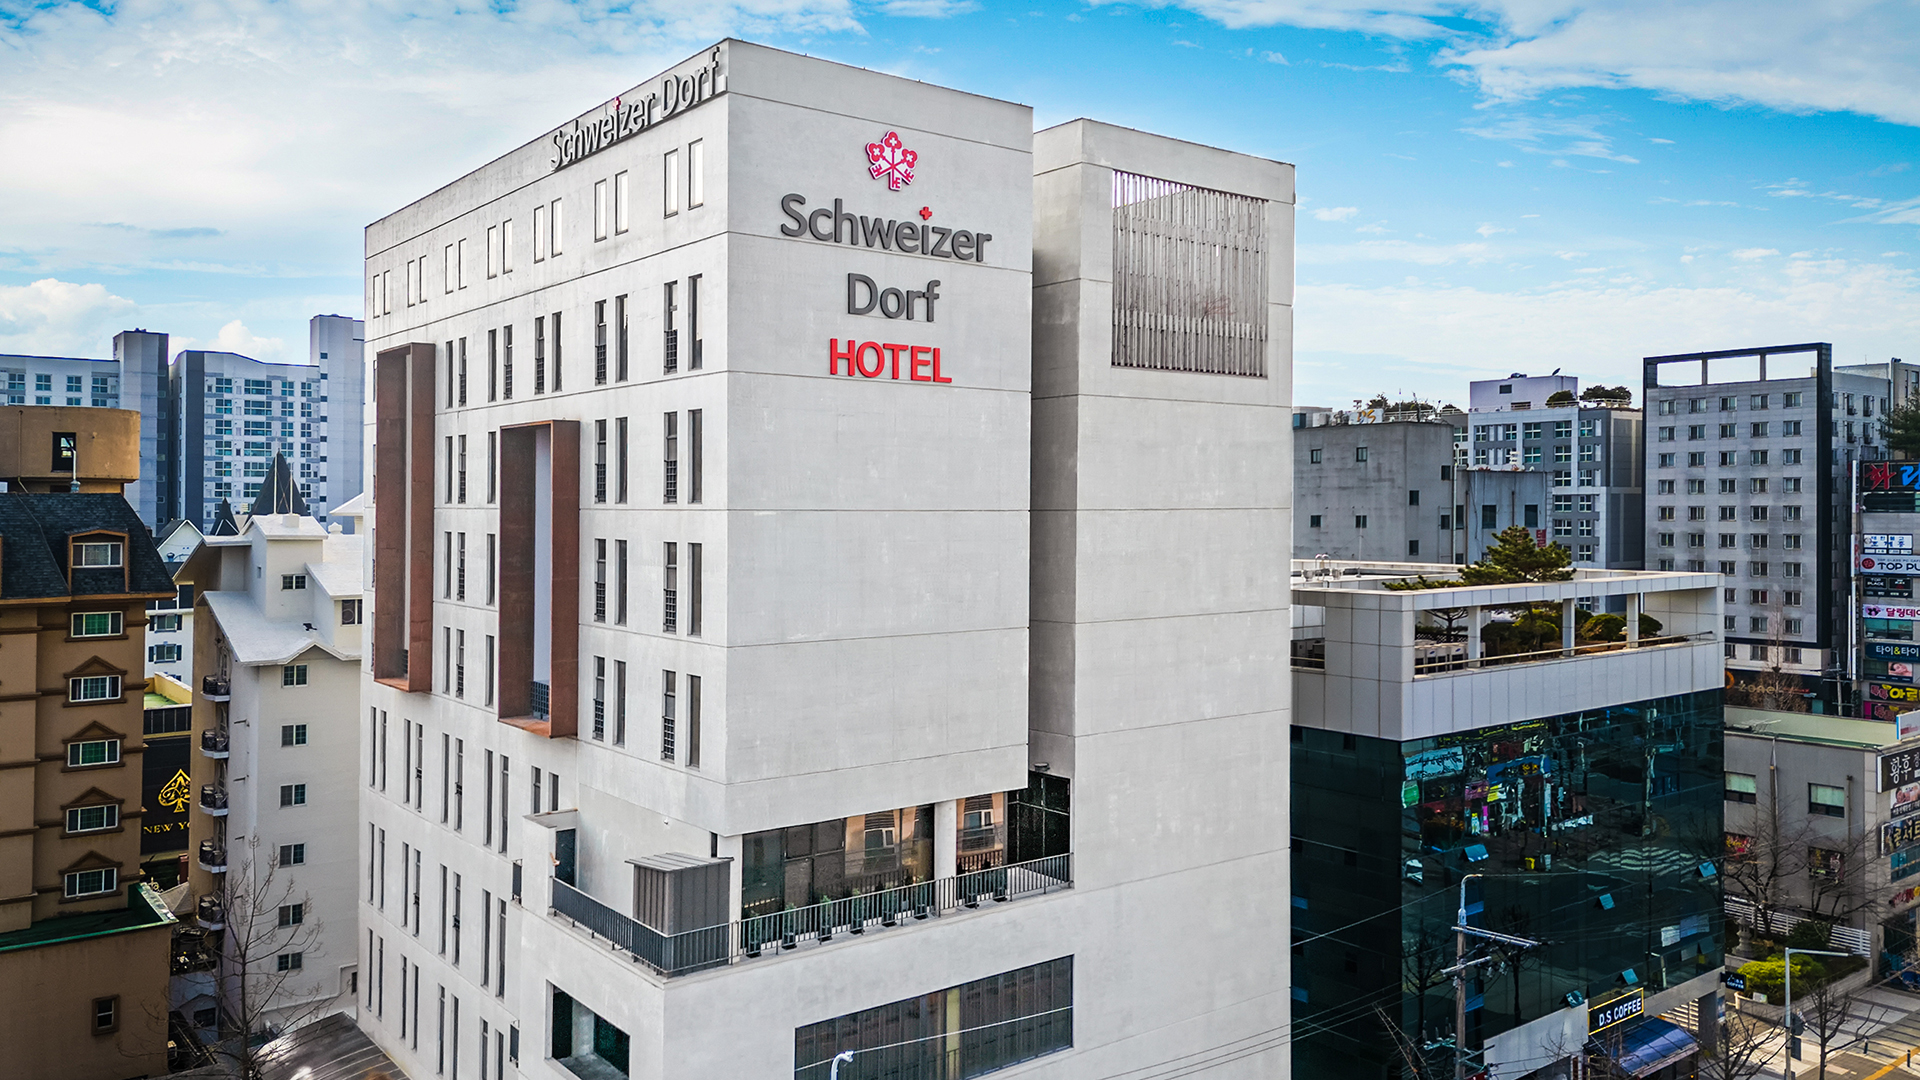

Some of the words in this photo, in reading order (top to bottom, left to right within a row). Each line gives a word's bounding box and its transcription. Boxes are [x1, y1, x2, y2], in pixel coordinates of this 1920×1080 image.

[551, 93, 656, 171] Schweizer
[661, 46, 720, 118] Dorf
[780, 193, 992, 262] Schweizer
[847, 272, 941, 322] Dorf
[830, 338, 952, 383] HOTEL
[1877, 562, 1903, 571] TOP
[1889, 754, 1912, 784] 황후
[143, 823, 173, 834] NEW
[1599, 1010, 1612, 1027] D.S
[1613, 997, 1642, 1019] COFFEE
